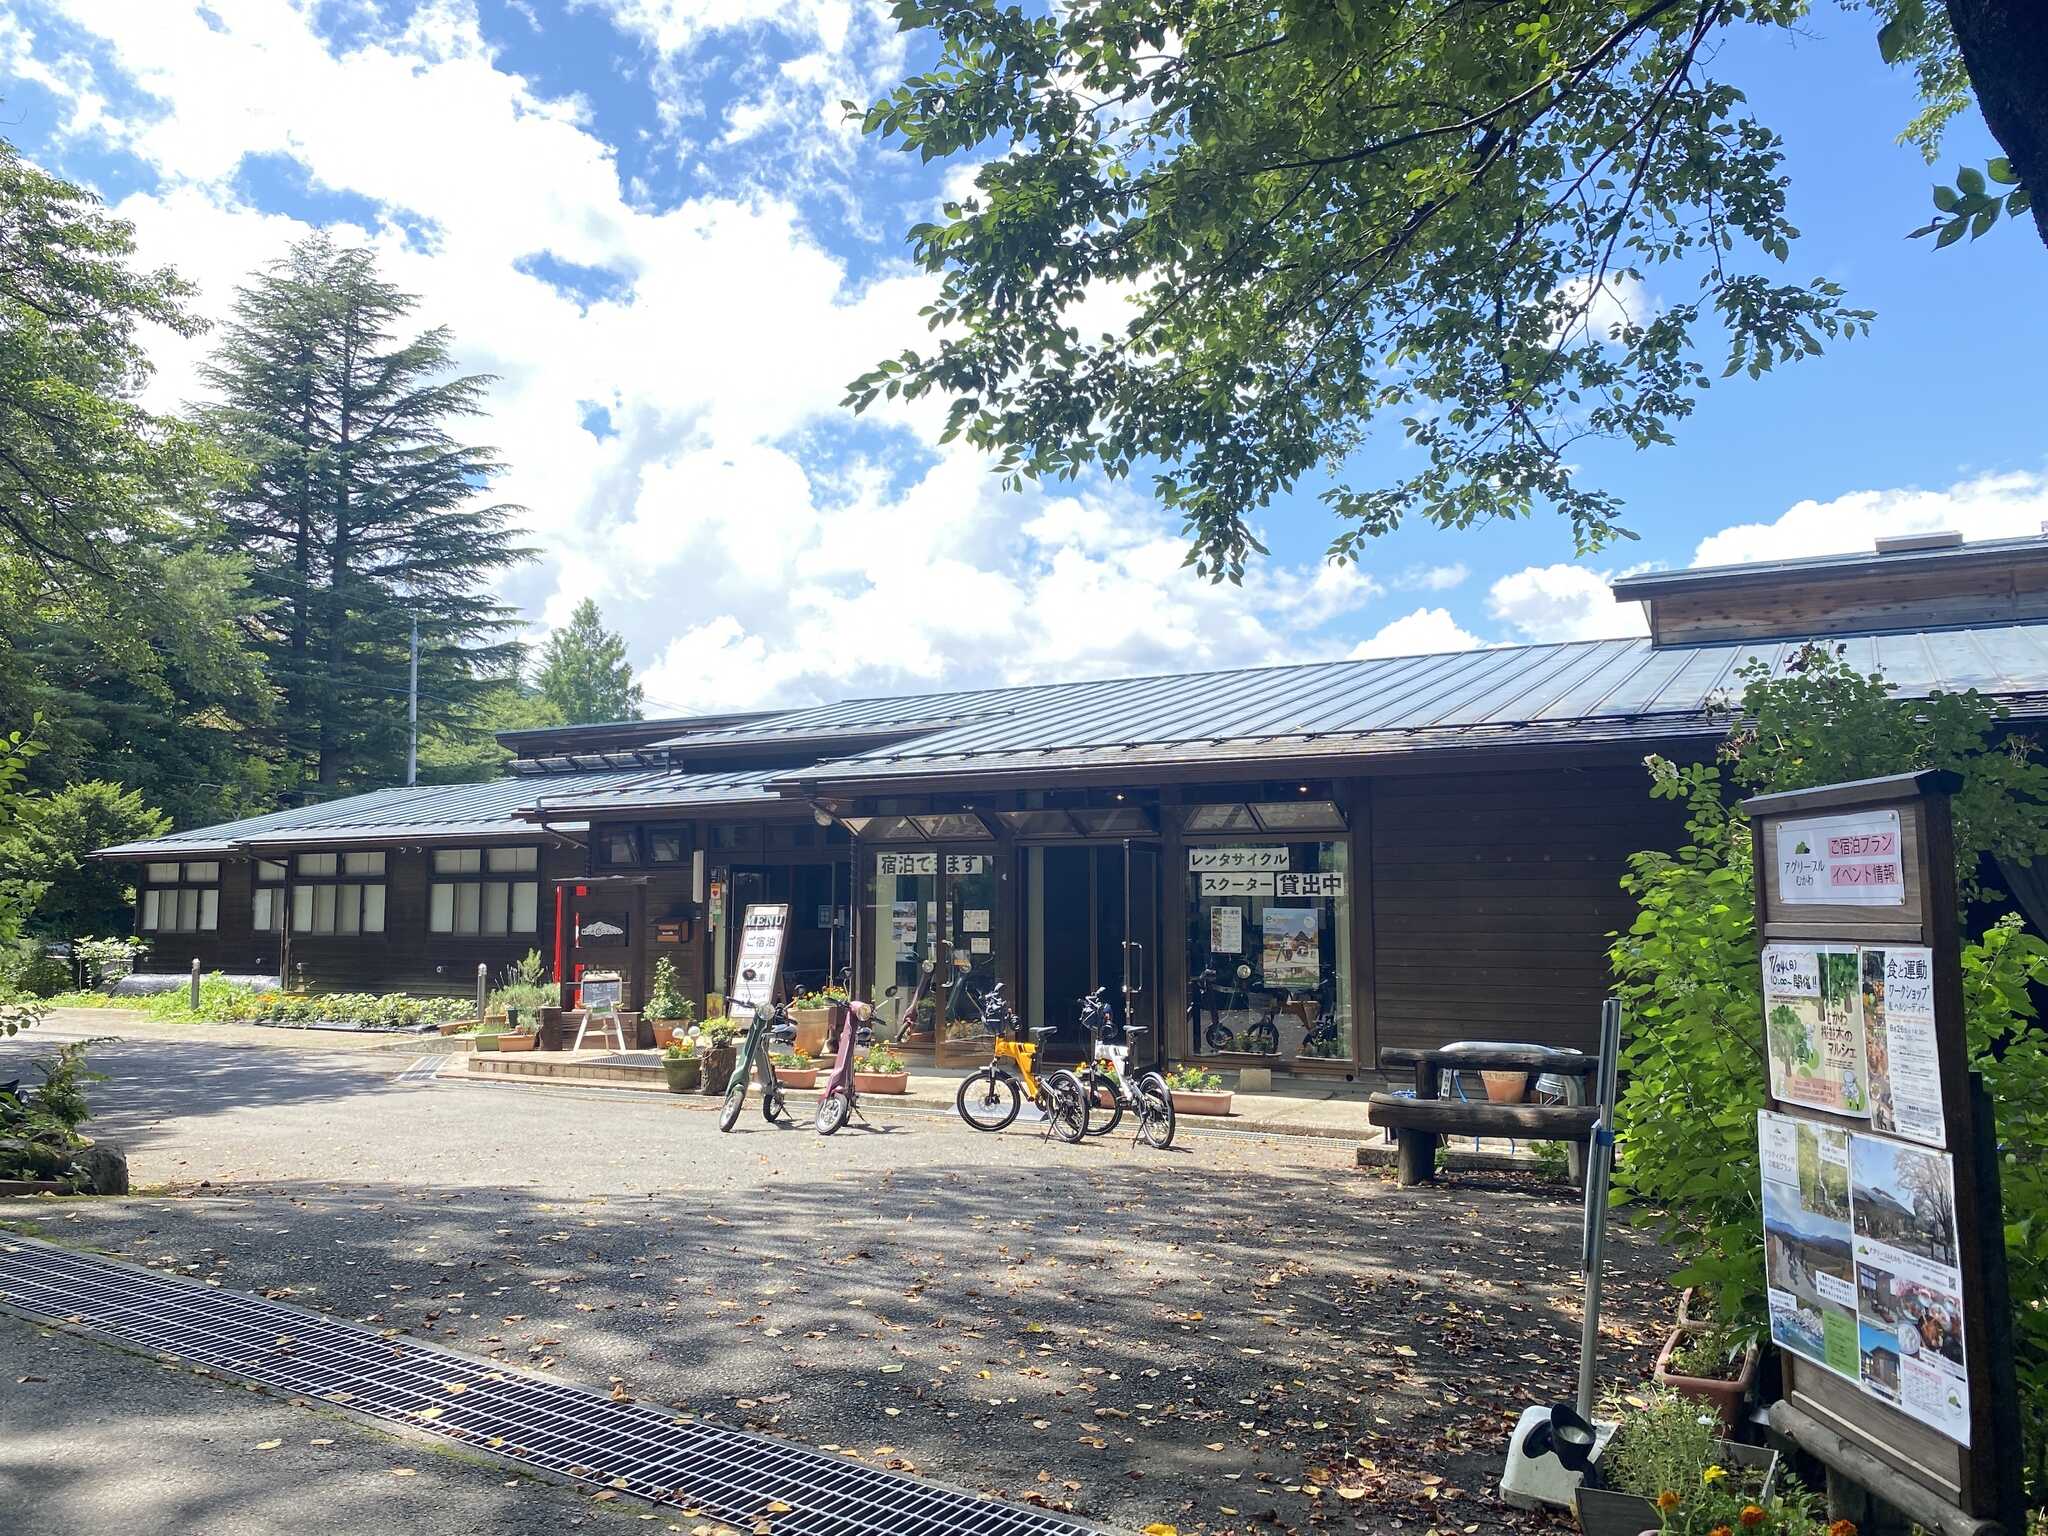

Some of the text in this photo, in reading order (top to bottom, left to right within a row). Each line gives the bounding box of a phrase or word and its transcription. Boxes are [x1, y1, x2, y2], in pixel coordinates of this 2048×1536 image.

[881, 855, 978, 874] 宿泊でます
[1191, 853, 1288, 867] レンタサイクル
[1796, 875, 1814, 887] むかわ
[1833, 864, 1896, 884] イベント情報
[1204, 874, 1342, 896] スクーター 貸出中
[745, 914, 785, 930] MENU
[747, 936, 776, 948] ご宿泊
[743, 961, 771, 969] レンタル
[1887, 958, 1927, 980] 食と運動
[1889, 984, 1930, 1000] ワークショップ
[1827, 1042, 1857, 1059] マルシェ
